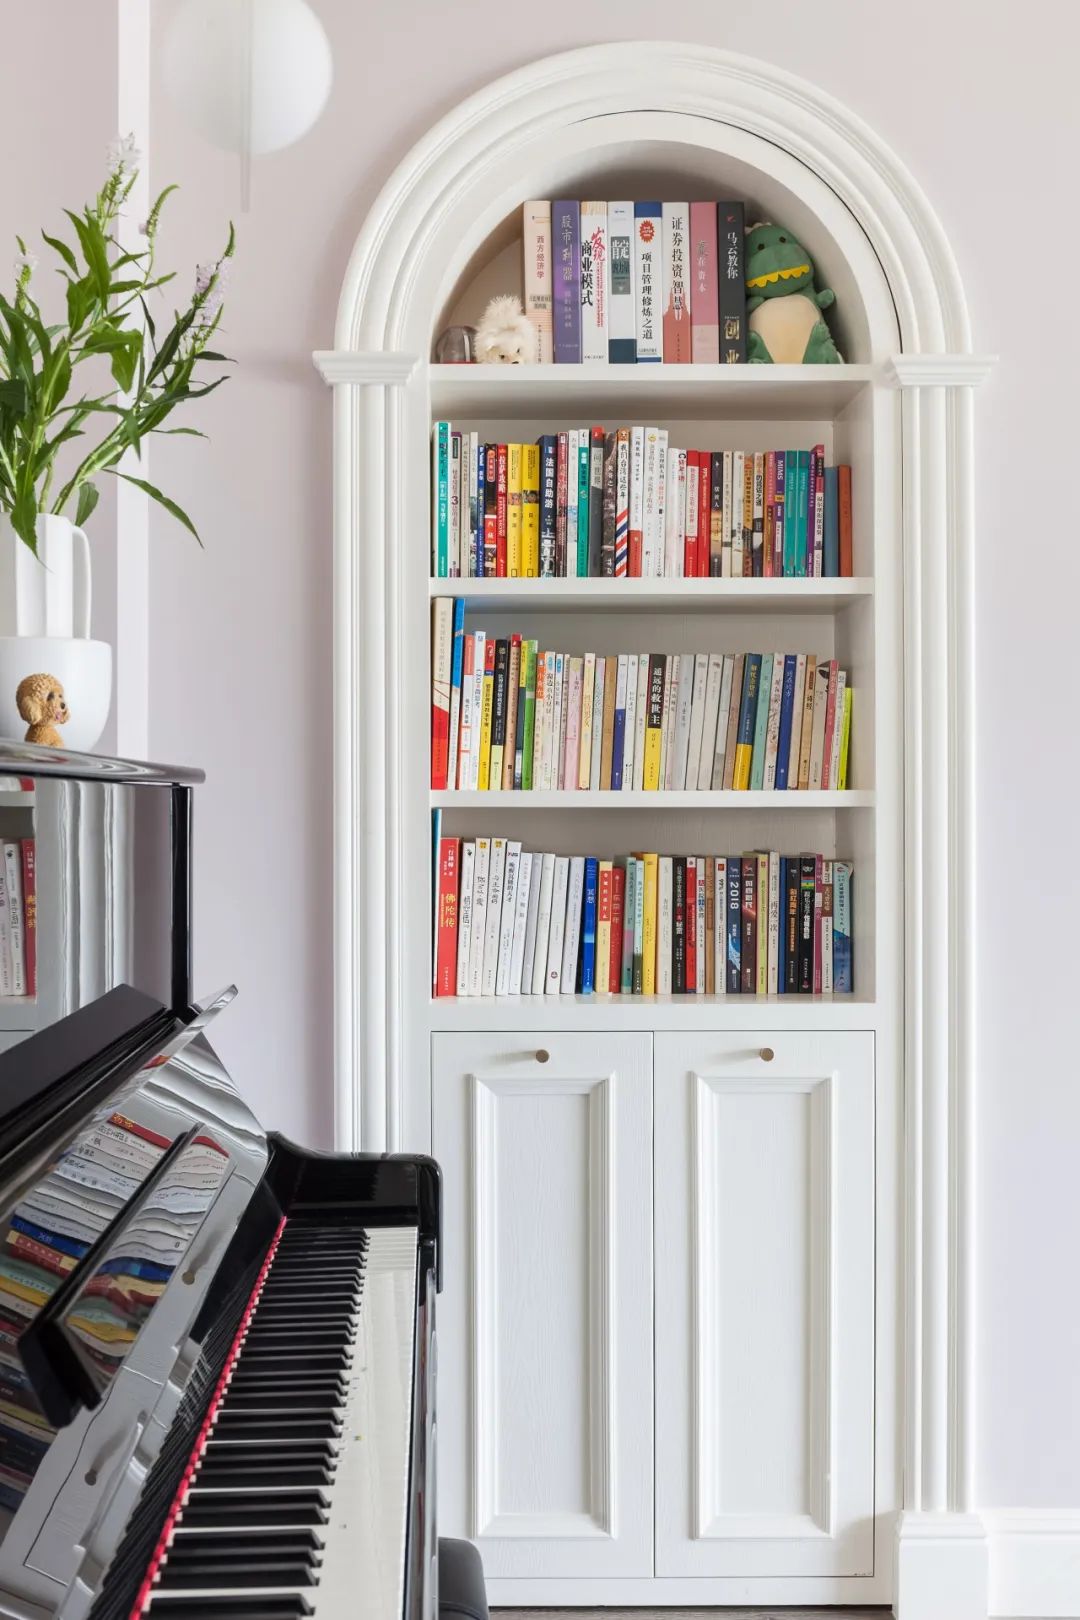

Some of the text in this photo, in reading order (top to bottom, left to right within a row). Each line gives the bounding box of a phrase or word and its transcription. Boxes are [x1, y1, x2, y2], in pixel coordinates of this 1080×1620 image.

[536, 235, 545, 279] 西方经济学
[580, 240, 593, 307] 商业模式
[671, 216, 684, 310] 证券投资智慧
[727, 231, 739, 279] 马云教你
[641, 251, 653, 340] 项目管理修炼之道
[544, 457, 555, 509] 法国自助游
[619, 443, 628, 499] 我们台湾这些年
[651, 667, 662, 725] 遥远的救世主
[445, 893, 456, 928] 佛陀传
[730, 881, 739, 910] 2018
